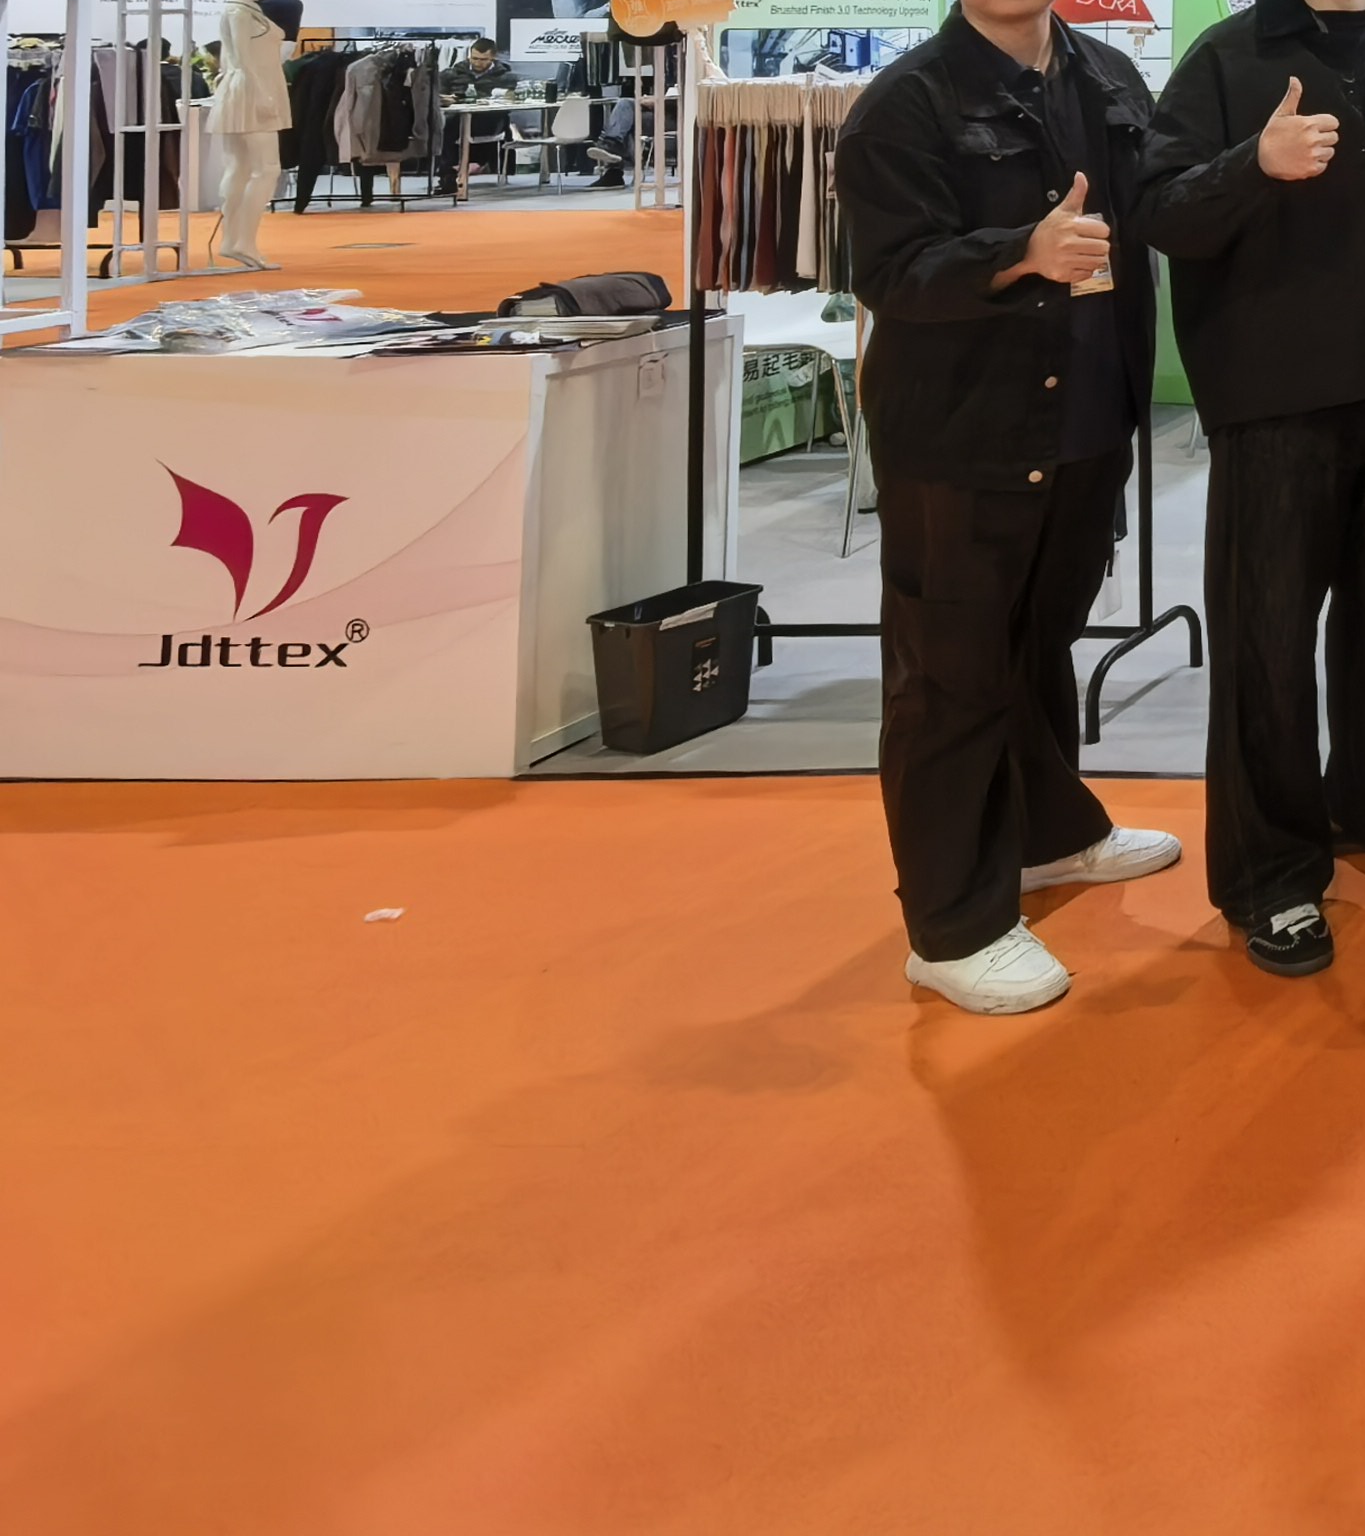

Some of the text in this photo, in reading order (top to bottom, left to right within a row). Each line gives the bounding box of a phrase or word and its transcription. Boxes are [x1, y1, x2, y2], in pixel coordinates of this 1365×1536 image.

[771, 5, 808, 15] Brushed
[810, 5, 835, 15] Finish
[837, 5, 851, 14] 3.0
[852, 6, 897, 17] Technology
